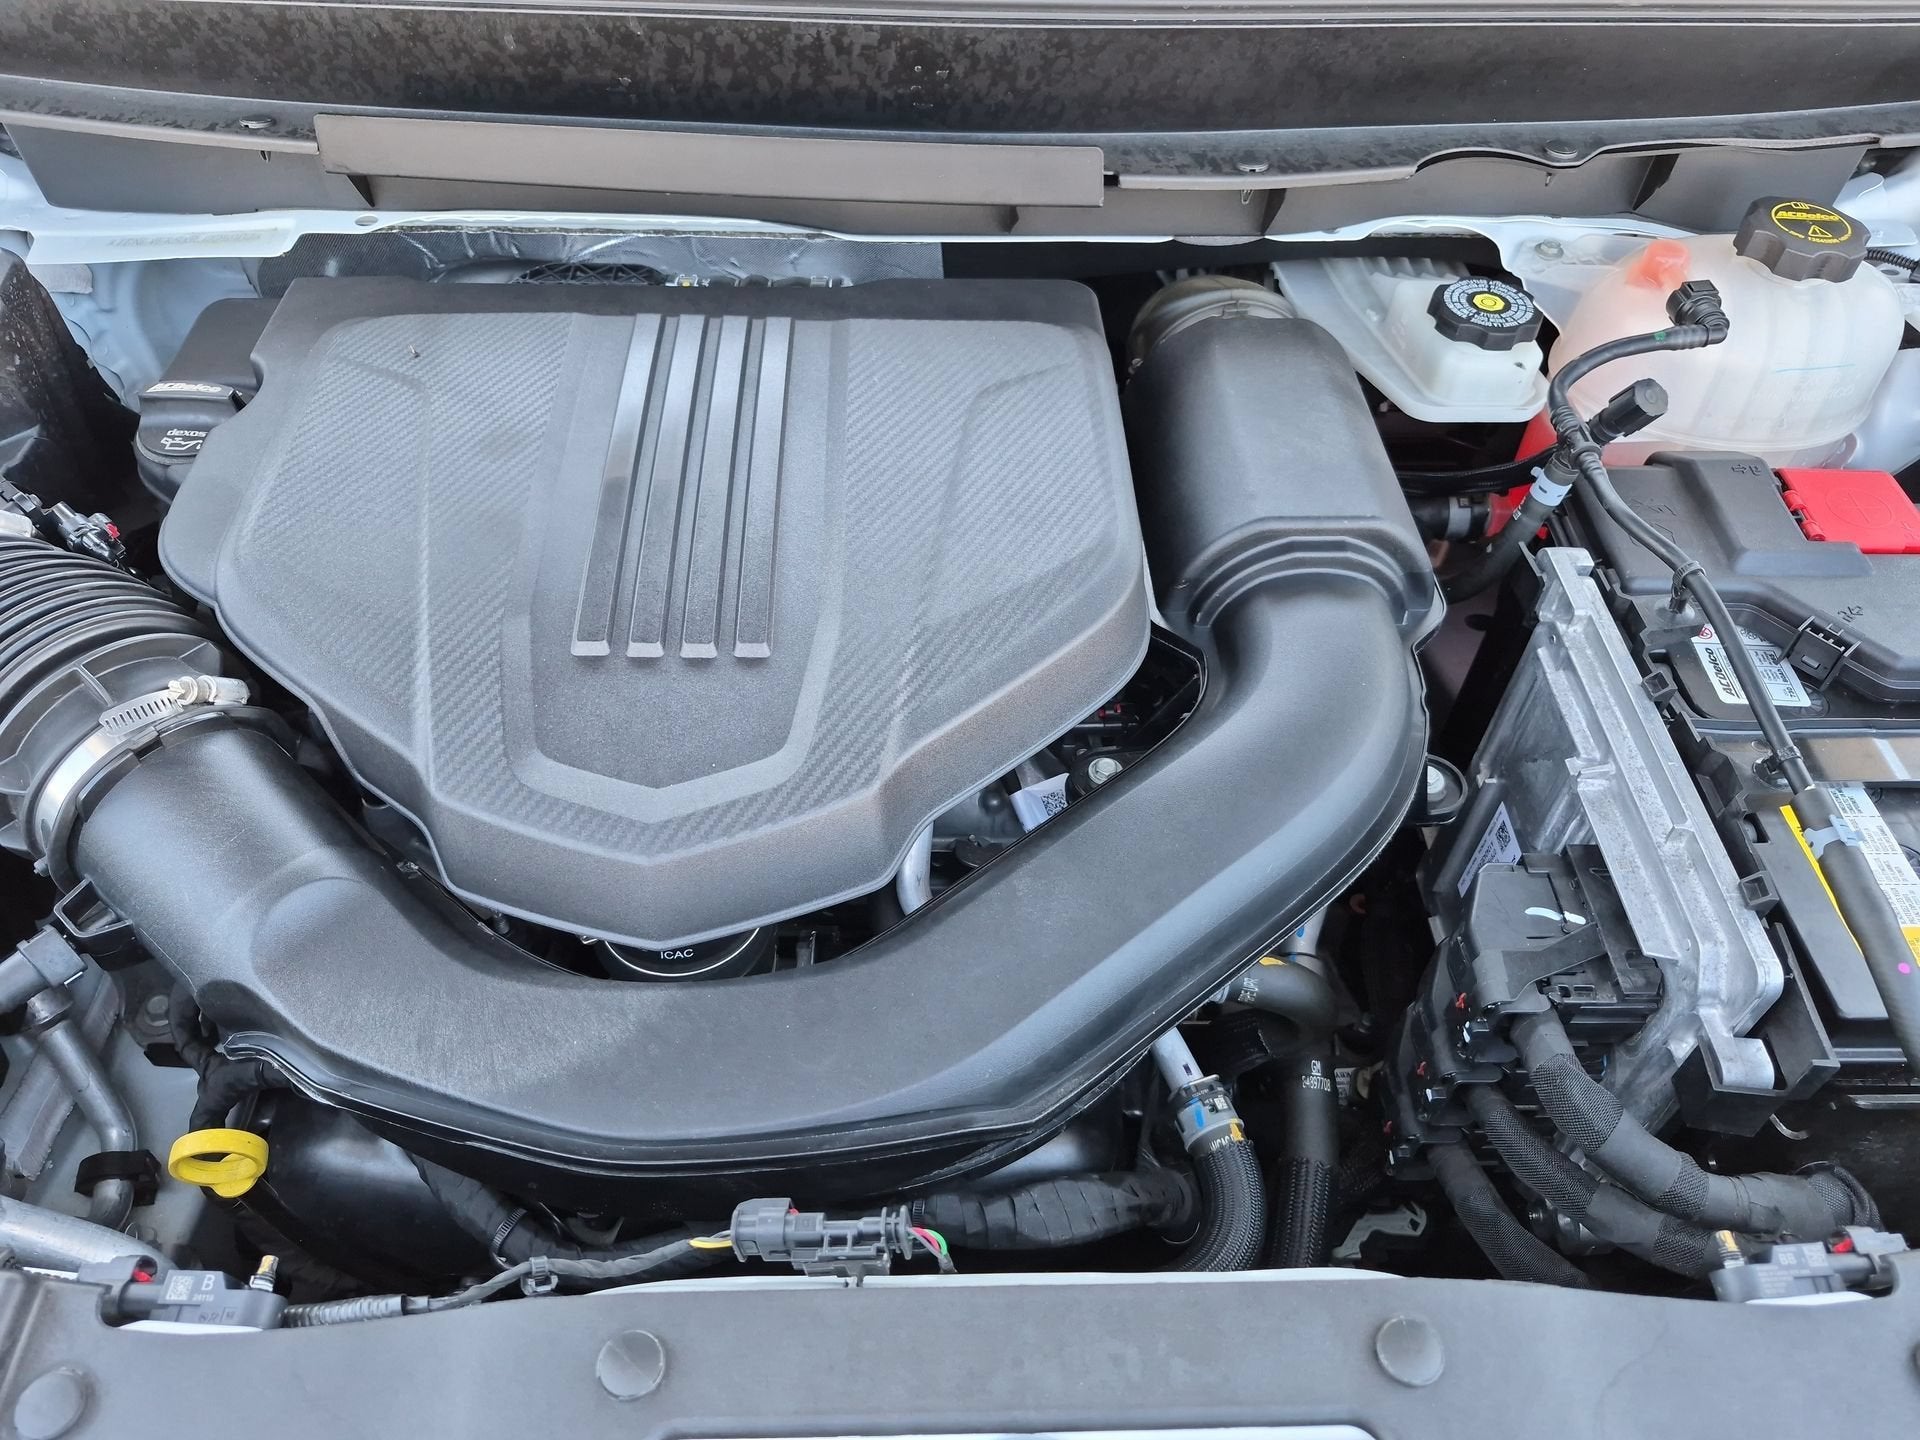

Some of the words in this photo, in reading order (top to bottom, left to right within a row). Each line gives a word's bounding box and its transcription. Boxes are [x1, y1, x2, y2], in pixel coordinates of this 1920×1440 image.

[1776, 210, 1840, 221] ACDelco
[145, 382, 222, 393] ACDelco
[166, 428, 208, 437] dexos
[1705, 647, 1735, 697] ACDelco
[660, 948, 694, 960] ICAC
[1310, 1060, 1321, 1075] GM
[201, 1274, 216, 1291] B
